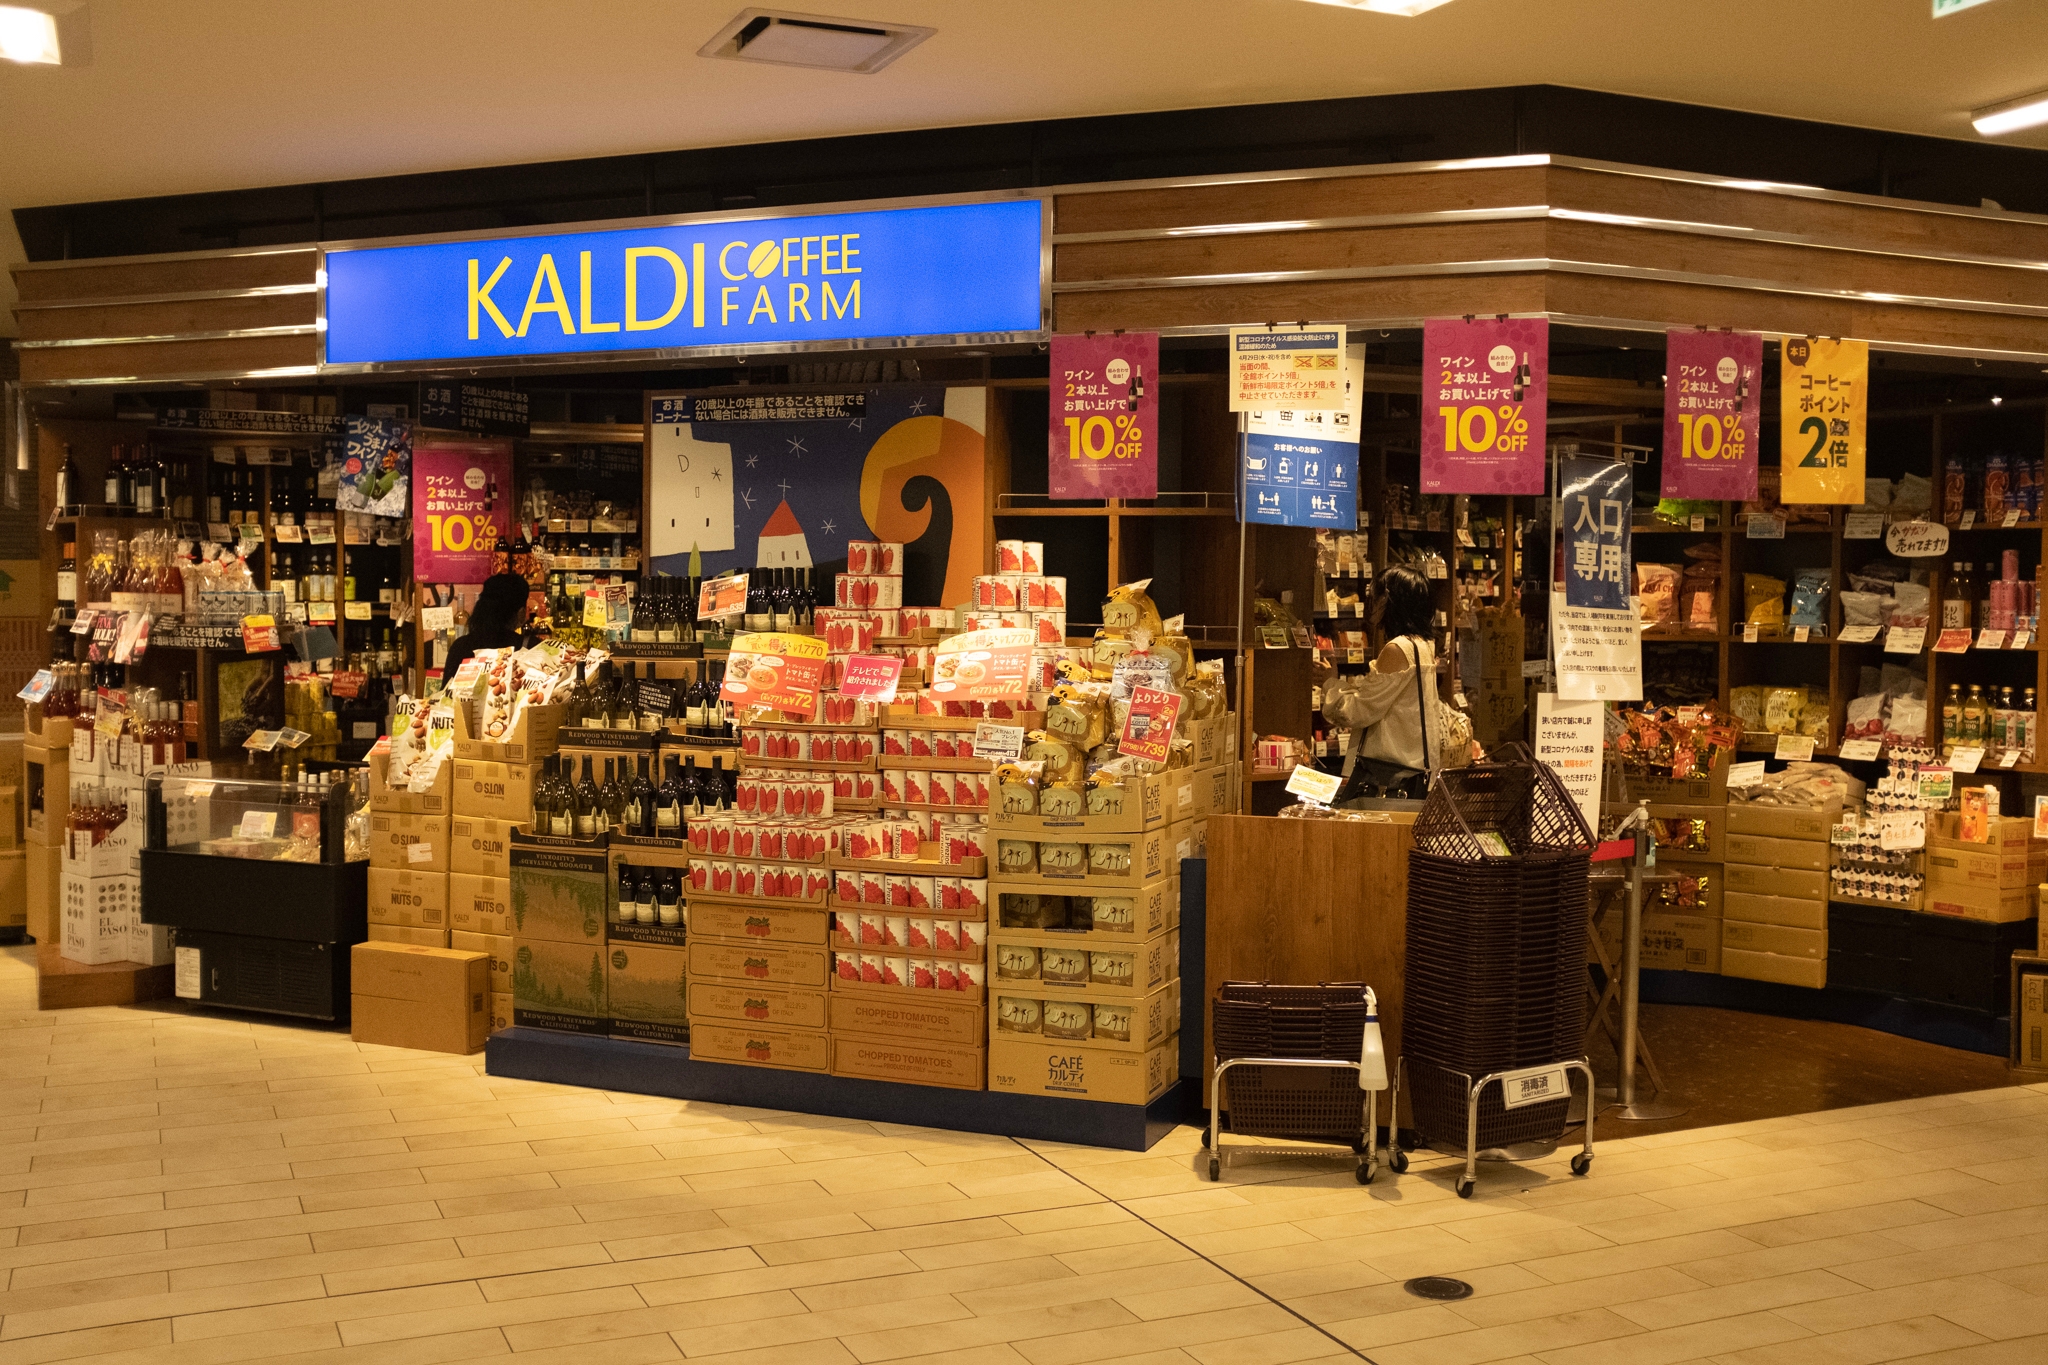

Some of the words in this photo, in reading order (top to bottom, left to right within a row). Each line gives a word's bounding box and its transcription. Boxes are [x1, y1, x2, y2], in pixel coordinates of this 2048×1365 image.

[468, 242, 706, 341] KALDI
[722, 278, 862, 327] FARM
[1790, 346, 1807, 358] 本日
[1239, 362, 1272, 371] 当面の間、
[1440, 355, 1476, 369] ワイン
[1064, 369, 1096, 382] ワイン
[1441, 369, 1492, 385] 2本以上
[1680, 365, 1708, 379] ワイン
[1065, 383, 1110, 397] 2本以上
[1680, 379, 1720, 395] 2本以上
[1800, 374, 1852, 393] コーヒー
[426, 387, 452, 404] お酒
[1439, 387, 1512, 402] お買い上げで
[422, 402, 456, 417] コーナー
[661, 400, 684, 411] お酒
[694, 394, 866, 411] 20歳以上の年齢であることを確認でき
[1064, 399, 1128, 412] お買い上げで
[1678, 396, 1734, 411] お買い上げで
[1799, 393, 1851, 414] ポイント
[655, 412, 691, 423] コーナー
[694, 407, 850, 421] ない場合には酒類を販売できません。
[160, 418, 195, 427] コーナー
[1439, 404, 1530, 453] 10%
[1064, 414, 1144, 460] 10%
[1496, 434, 1529, 452] OFF
[1678, 413, 1747, 460] 10%
[1797, 416, 1850, 468] 2倍
[346, 440, 378, 461] ワイン
[1114, 442, 1144, 459] OFF
[1273, 443, 1323, 456] お客様へのお願い
[1721, 443, 1746, 460] OFF
[426, 474, 455, 487] ワイン
[426, 487, 468, 499] 2本以上
[426, 500, 484, 512] お買い上げで
[1573, 494, 1623, 538] 入口
[426, 514, 498, 553] 10%
[1890, 526, 1929, 538] 今かなり
[1573, 540, 1622, 583] 専用
[729, 602, 744, 612] 635
[96, 616, 112, 629] PINK
[999, 634, 1032, 645] ¥1,770
[650, 643, 690, 651] VINEYARDS
[792, 643, 824, 657] ¥1,770
[993, 658, 1019, 667] トマト缶
[785, 669, 811, 679] トマト缶
[852, 666, 881, 677] テレビで
[1134, 691, 1170, 705] よりどり
[568, 731, 600, 739] REDWOOD
[684, 737, 723, 745] CALIFORNIA
[456, 742, 473, 751] KALDI
[1540, 745, 1595, 754] 新型コロナウイルス感染
[166, 762, 200, 776] PASO
[484, 781, 505, 796] NUTS
[995, 812, 1014, 821] カルディ
[99, 837, 127, 849] PASO
[483, 838, 504, 855] NUTS
[536, 837, 576, 846] CALIFORNIA
[634, 838, 676, 846] CALIFORNIA
[391, 892, 412, 906] NUTS
[474, 899, 495, 913] NUTS
[99, 924, 128, 936] PASO
[131, 925, 149, 938] PASO
[615, 925, 649, 934] REDWOOD
[651, 928, 687, 938] VINEYARD
[67, 933, 85, 948] PASO
[633, 933, 674, 944] CALIFORNIA
[522, 1011, 557, 1021] REDWOOD
[557, 1015, 595, 1025] VINEYARDS
[855, 1007, 899, 1020] CHOPPED
[900, 1011, 950, 1025] TOMATOES
[540, 1020, 579, 1030] CALIFORNIA
[615, 1020, 650, 1030] REDWOOD
[651, 1024, 690, 1035] VINEYARDS
[633, 1029, 674, 1039] CALIFORNIA
[857, 1049, 901, 1063] CHOPPED
[902, 1054, 952, 1068] TOMATOES
[1048, 1055, 1084, 1071] CAFÉ
[996, 1075, 1016, 1083] カルディ
[1048, 1069, 1084, 1083] カルディ
[1520, 1075, 1549, 1092] 消毒済
